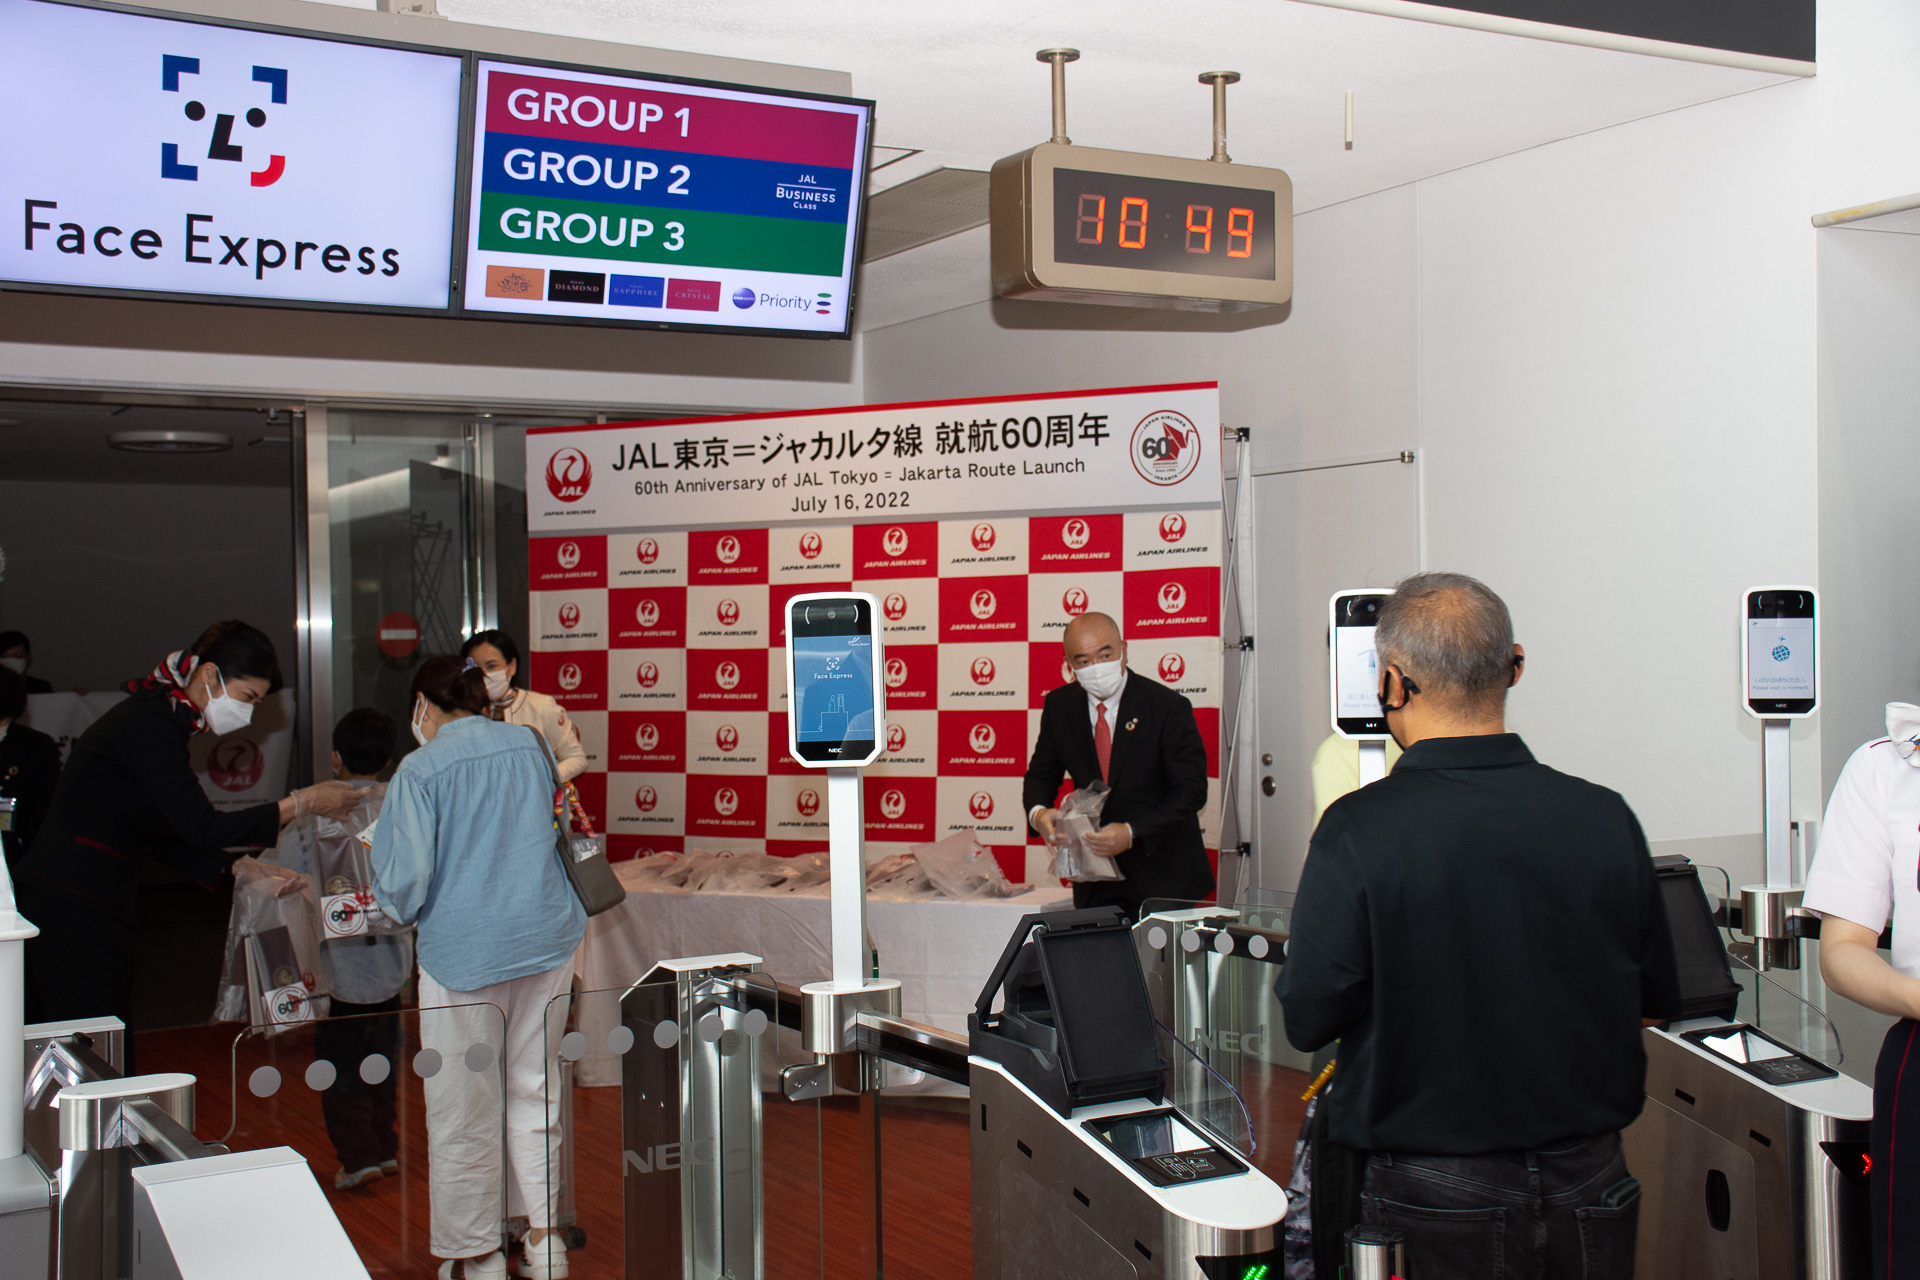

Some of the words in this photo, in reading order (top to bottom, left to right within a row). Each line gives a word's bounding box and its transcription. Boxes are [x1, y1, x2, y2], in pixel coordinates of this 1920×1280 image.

[507, 88, 663, 133] GROUP
[675, 107, 690, 138] 1
[503, 148, 659, 191] GROUP
[667, 164, 691, 195] 2
[798, 174, 816, 184] JAL
[776, 186, 836, 203] BUSINESS
[794, 202, 816, 210] CLASS
[499, 207, 654, 248] GROUP
[662, 221, 685, 252] 3
[1096, 196, 1149, 250] 10
[1186, 204, 1254, 258] 49
[24, 198, 162, 260] Face
[186, 213, 400, 280] Express
[555, 283, 600, 292] DIAMOND
[614, 288, 659, 296] SAPPHIRE
[675, 292, 712, 300] CRYSTAL
[760, 294, 812, 312] Priority
[936, 412, 1110, 455] 就航60周年
[1142, 437, 1171, 459] 60
[634, 480, 668, 496] 60th
[674, 476, 765, 494] Anniversary
[772, 473, 788, 488] of
[794, 472, 823, 487] JAL
[830, 470, 878, 486] Tokyo
[900, 465, 962, 482] Jakarta
[968, 461, 1016, 478] Route
[1023, 458, 1085, 474] Launch
[557, 486, 584, 498] JAL
[792, 496, 828, 513] July
[834, 494, 860, 511] 16,
[864, 491, 910, 508] 2022
[1069, 552, 1110, 560] AIRLINES
[1165, 616, 1208, 625] AIRLINES
[222, 776, 252, 787] JAL
[330, 910, 347, 922] 60
[277, 1002, 292, 1014] 60
[622, 1137, 714, 1176] NEC
